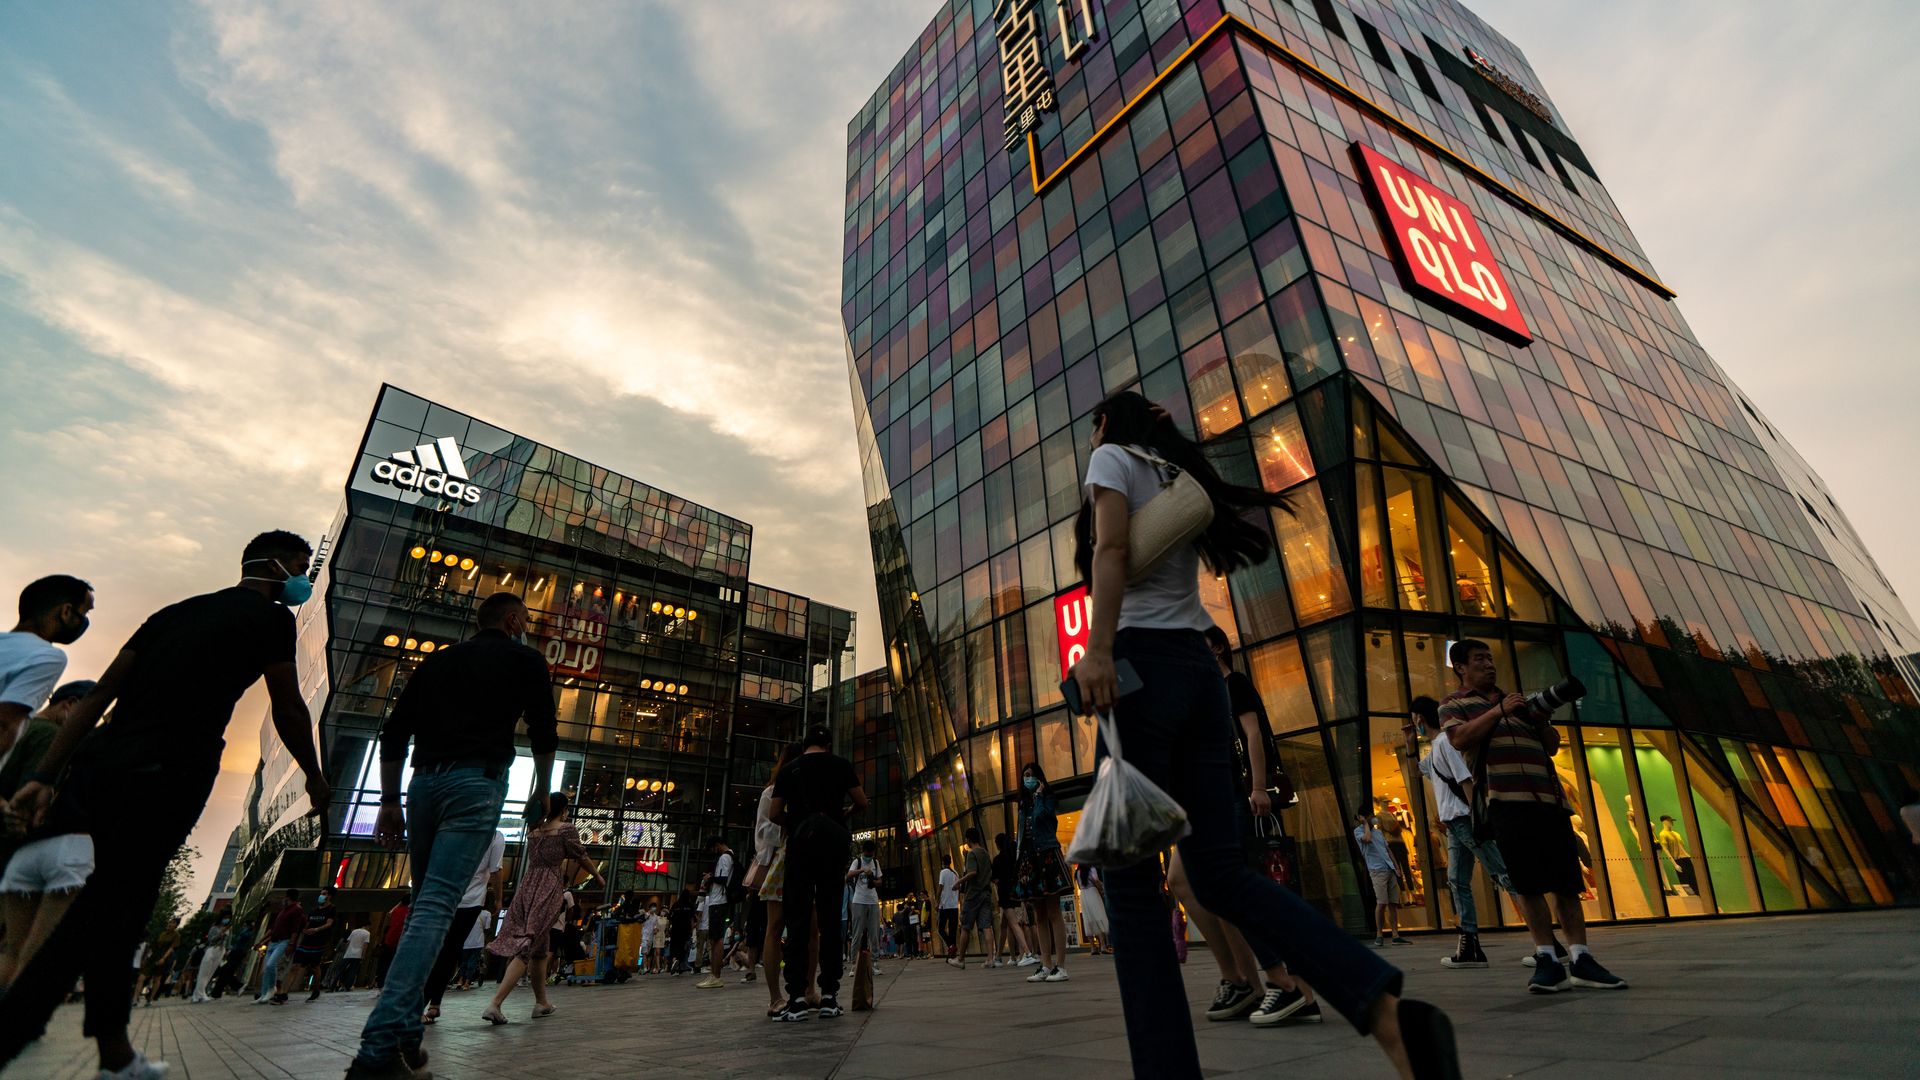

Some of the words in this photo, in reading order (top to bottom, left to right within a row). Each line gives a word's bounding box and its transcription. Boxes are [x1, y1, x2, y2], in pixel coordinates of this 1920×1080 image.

[993, 0, 1050, 124] 古里
[1003, 88, 1053, 150] 三里屯
[1379, 165, 1477, 253] UNI
[1407, 227, 1508, 312] QLO
[372, 460, 481, 505] adidas
